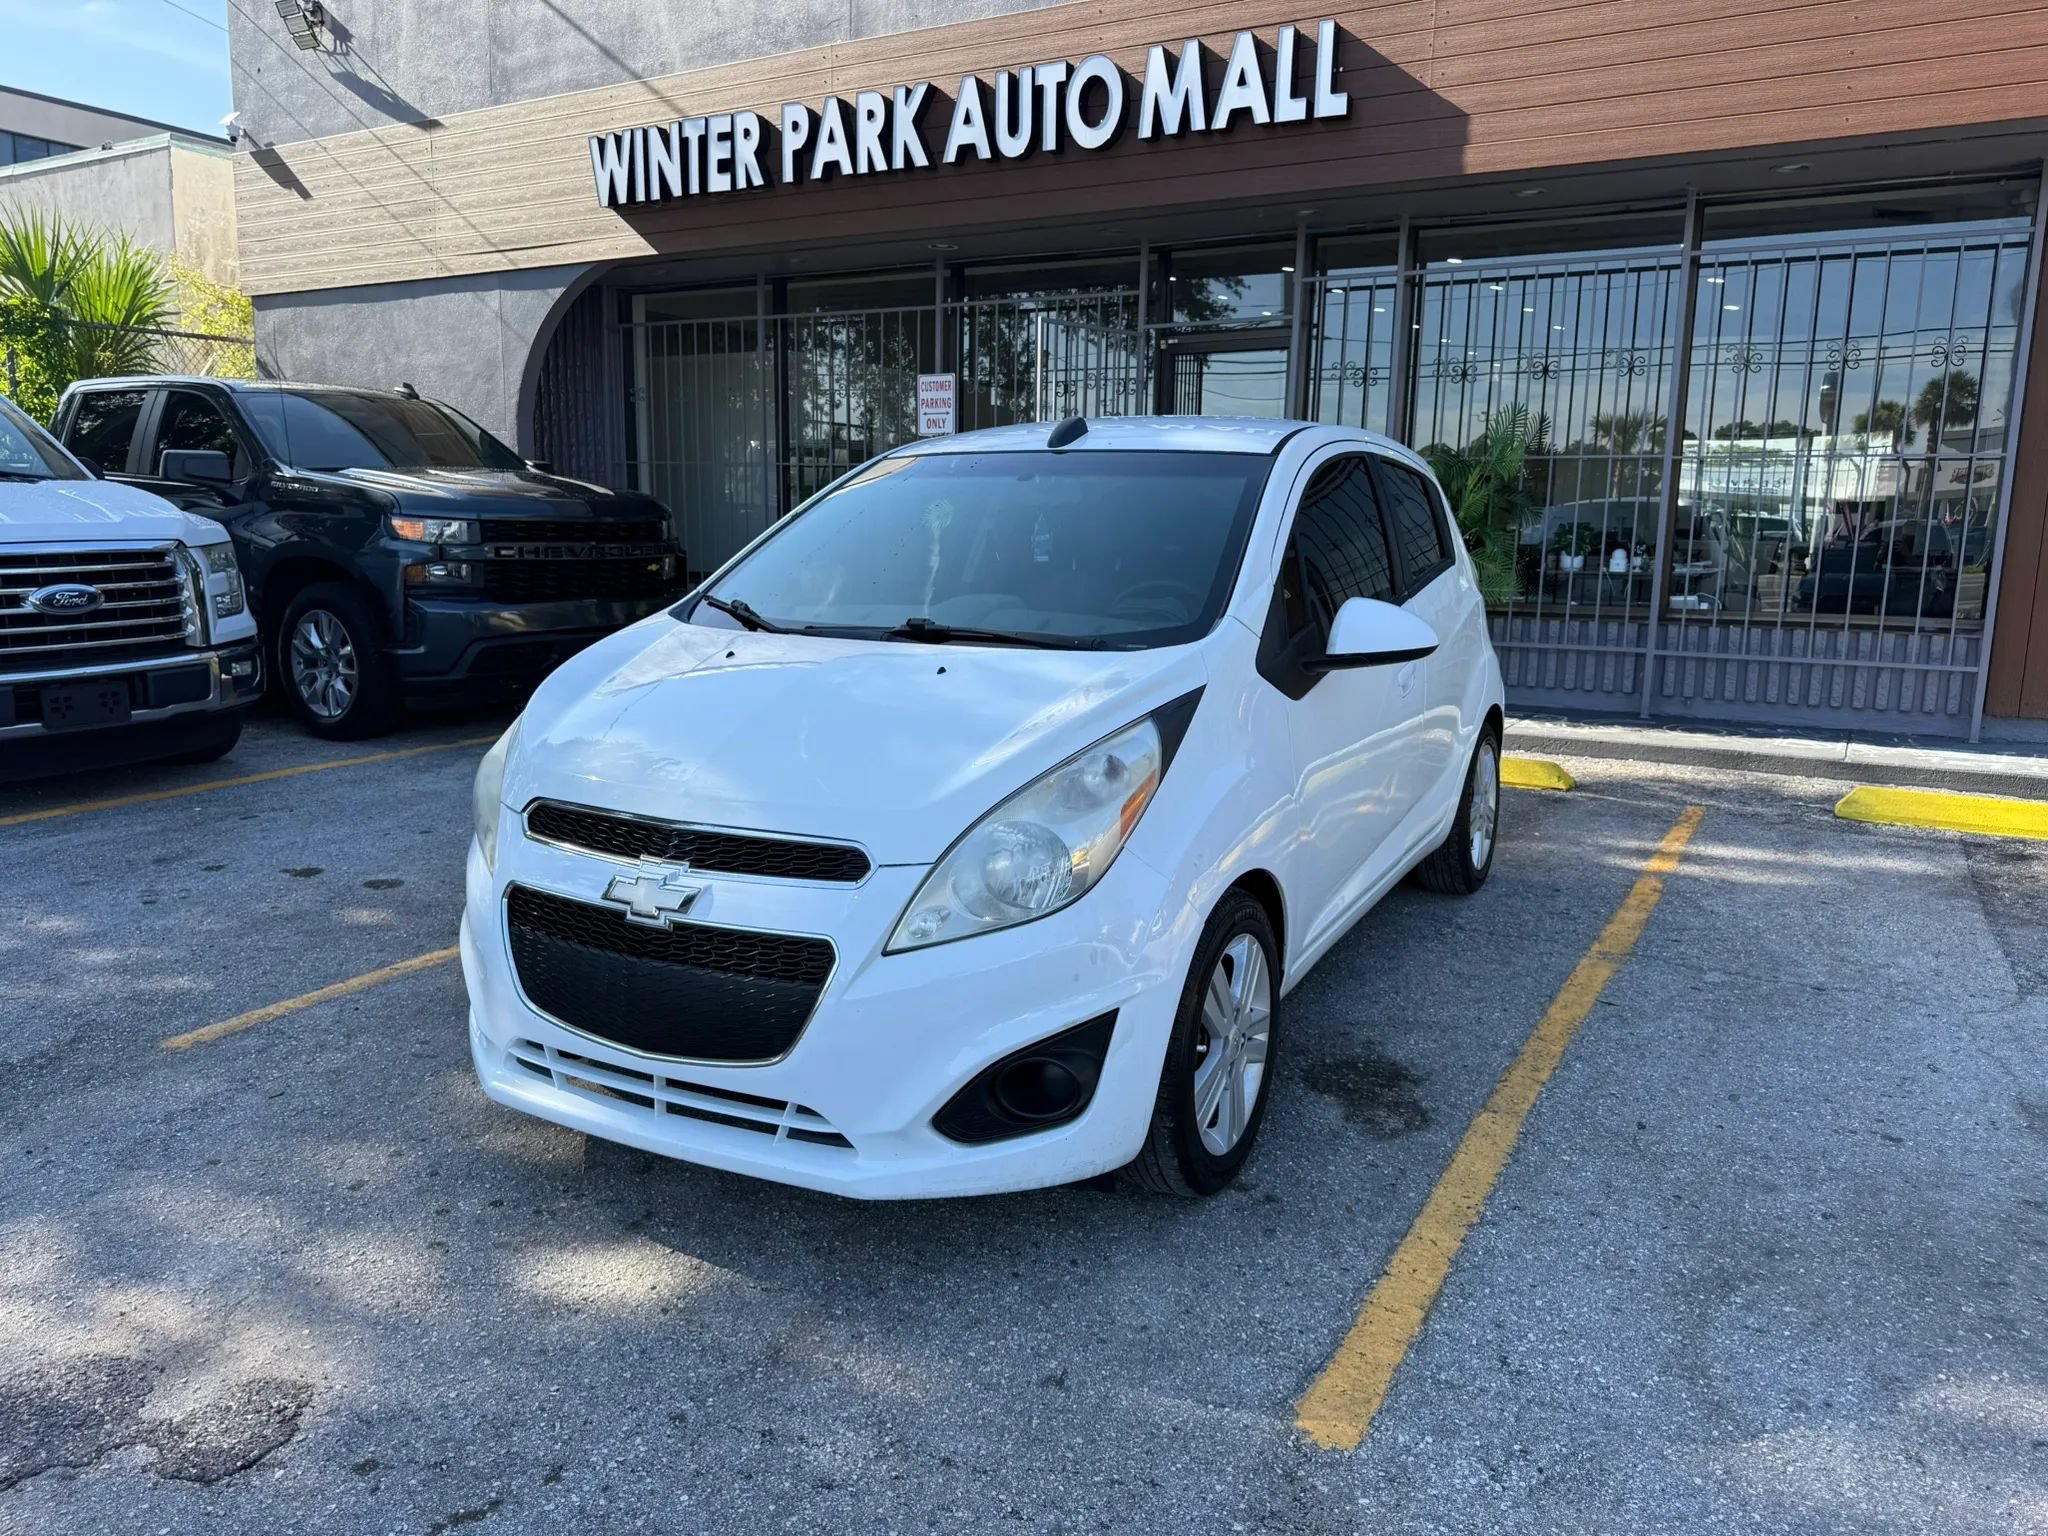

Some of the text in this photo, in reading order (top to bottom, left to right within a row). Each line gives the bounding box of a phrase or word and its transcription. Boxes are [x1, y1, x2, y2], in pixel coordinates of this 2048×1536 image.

[588, 18, 1349, 208] WINTER PARK AUTO MALL
[921, 380, 952, 392] CUSTOMER
[921, 397, 952, 409] PARKING
[927, 417, 947, 430] ONLY
[494, 544, 668, 559] CHEVROLET
[52, 591, 89, 607] Ford
